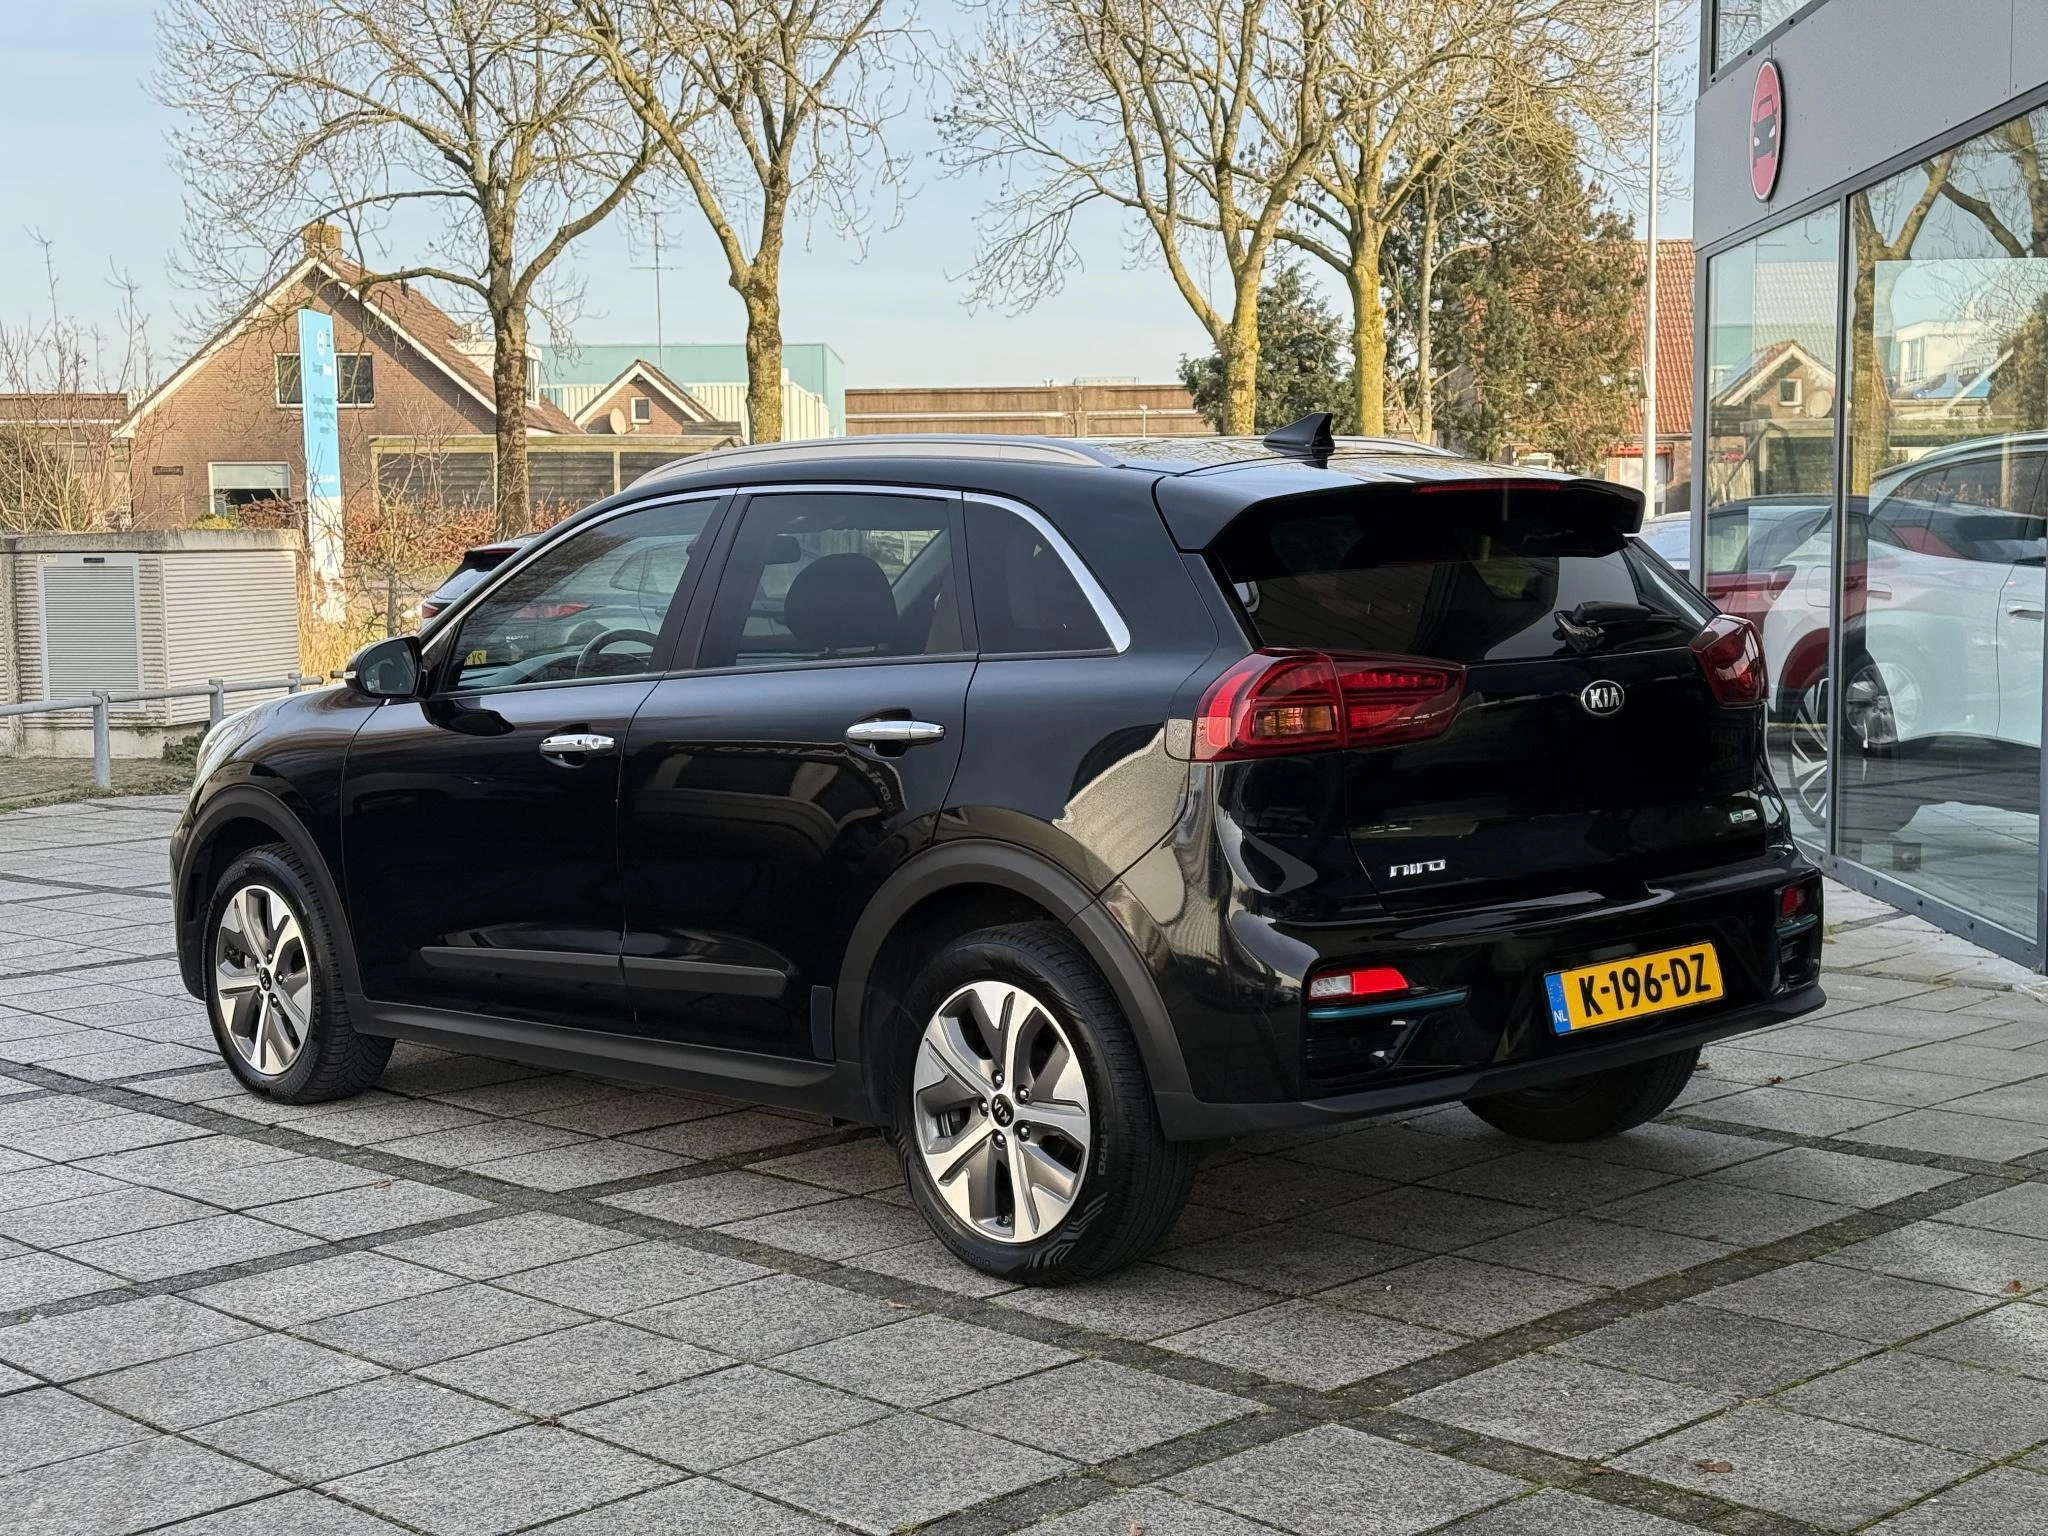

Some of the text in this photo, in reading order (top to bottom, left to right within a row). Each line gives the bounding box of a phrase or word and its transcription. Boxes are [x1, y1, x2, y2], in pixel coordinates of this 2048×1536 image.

[1589, 686, 1620, 708] KIA
[1389, 859, 1446, 877] niro
[1579, 952, 1712, 1018] K-196-DZ
[1552, 1010, 1569, 1024] NL
[993, 1098, 1011, 1124] KIA
